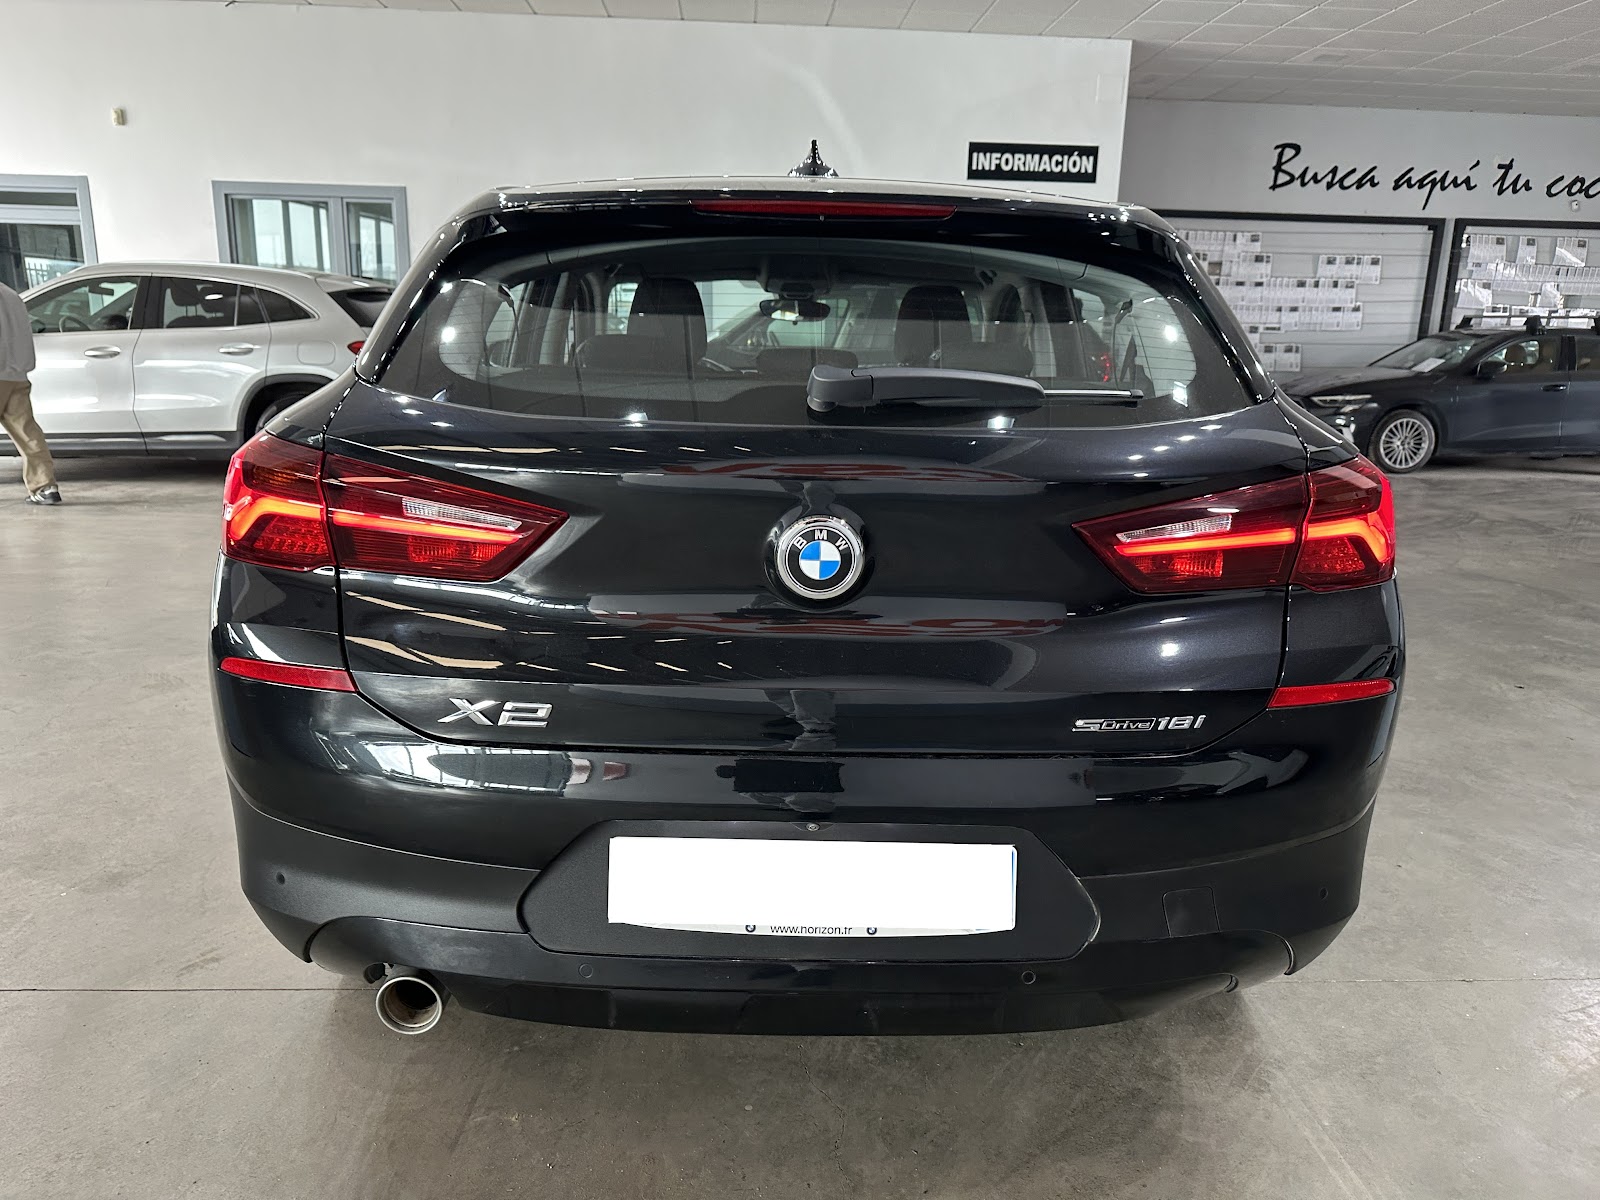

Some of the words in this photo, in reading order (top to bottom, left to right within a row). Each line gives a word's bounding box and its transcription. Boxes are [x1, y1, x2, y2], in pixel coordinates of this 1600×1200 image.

[971, 151, 1094, 174] INFORMACIÓN
[1268, 142, 1380, 192] Busca
[1392, 159, 1480, 211] aquí
[1492, 158, 1533, 197] tu
[793, 529, 849, 551] BMW
[437, 697, 554, 728] X2
